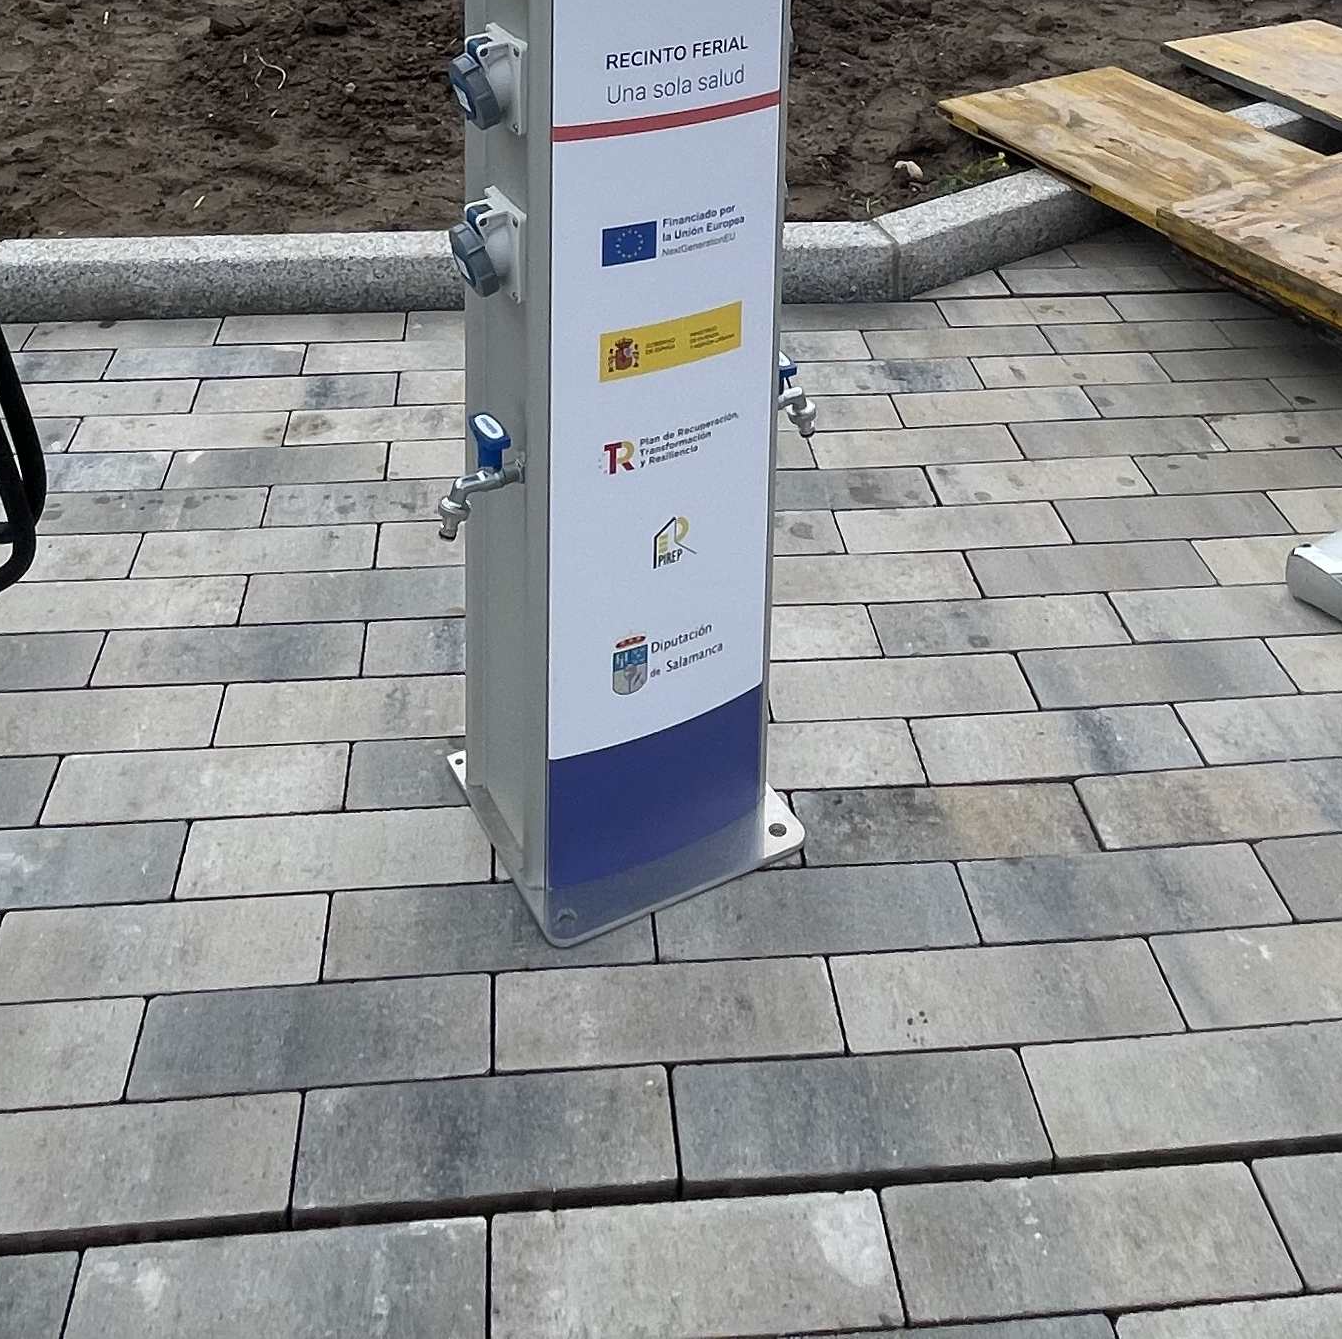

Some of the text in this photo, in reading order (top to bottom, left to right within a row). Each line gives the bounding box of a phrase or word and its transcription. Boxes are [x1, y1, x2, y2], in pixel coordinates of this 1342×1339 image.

[606, 35, 749, 70] RECINTO FERIAL
[607, 64, 745, 105] Una sola salud
[663, 204, 737, 228] Financiado por
[663, 230, 672, 242] la
[706, 215, 745, 234] Europea
[639, 431, 712, 457] Transformación
[640, 434, 661, 447] Plan
[662, 431, 675, 441] de
[658, 549, 683, 567] PIREP
[651, 623, 713, 654] Diputación
[650, 642, 723, 678] de Salamanca
